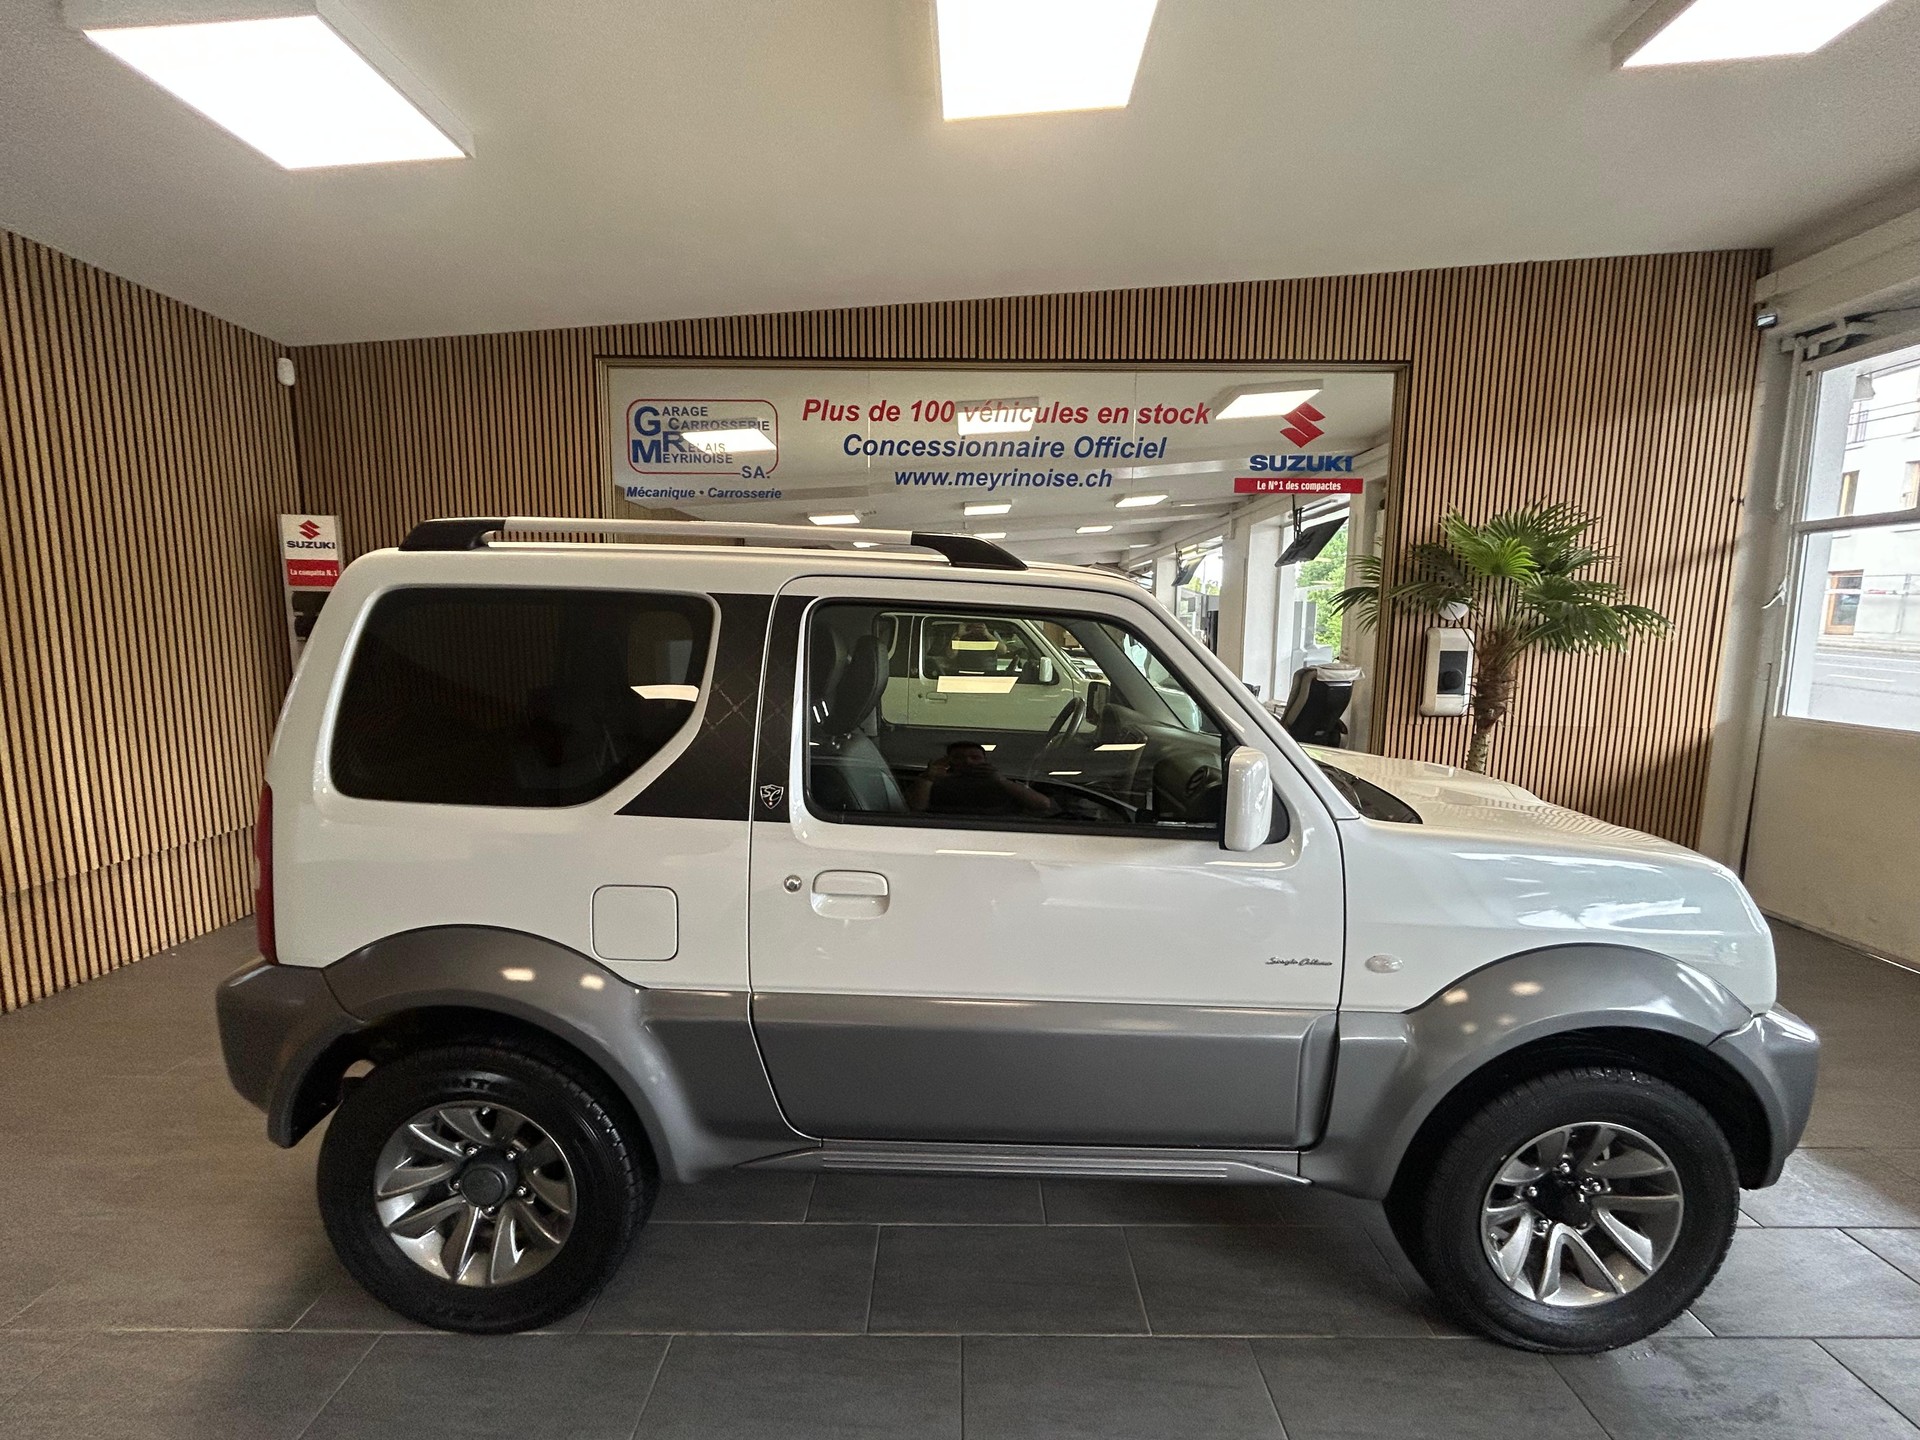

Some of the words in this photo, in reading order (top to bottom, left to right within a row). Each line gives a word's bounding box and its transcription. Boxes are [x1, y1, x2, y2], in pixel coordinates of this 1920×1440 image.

[801, 399, 860, 422] Plus
[868, 400, 900, 422] de
[911, 400, 956, 423] 100
[964, 400, 1089, 424] véhicules
[1097, 406, 1129, 424] en
[1137, 402, 1211, 424] stock
[668, 417, 770, 431] CARROSSERIE
[631, 439, 733, 464] MEYRINOISE
[843, 433, 1065, 458] Concessionnaire
[1074, 435, 1168, 459] Officiel
[1250, 454, 1353, 472] SUZUKI
[894, 468, 1112, 491] www.meyrinoise.ch
[1256, 480, 1266, 490] Le
[1285, 480, 1299, 491] des
[1300, 481, 1342, 492] compactes
[626, 486, 695, 500] Mécanique
[707, 487, 782, 498] Carrosserie
[286, 540, 336, 549] SUZUKI
